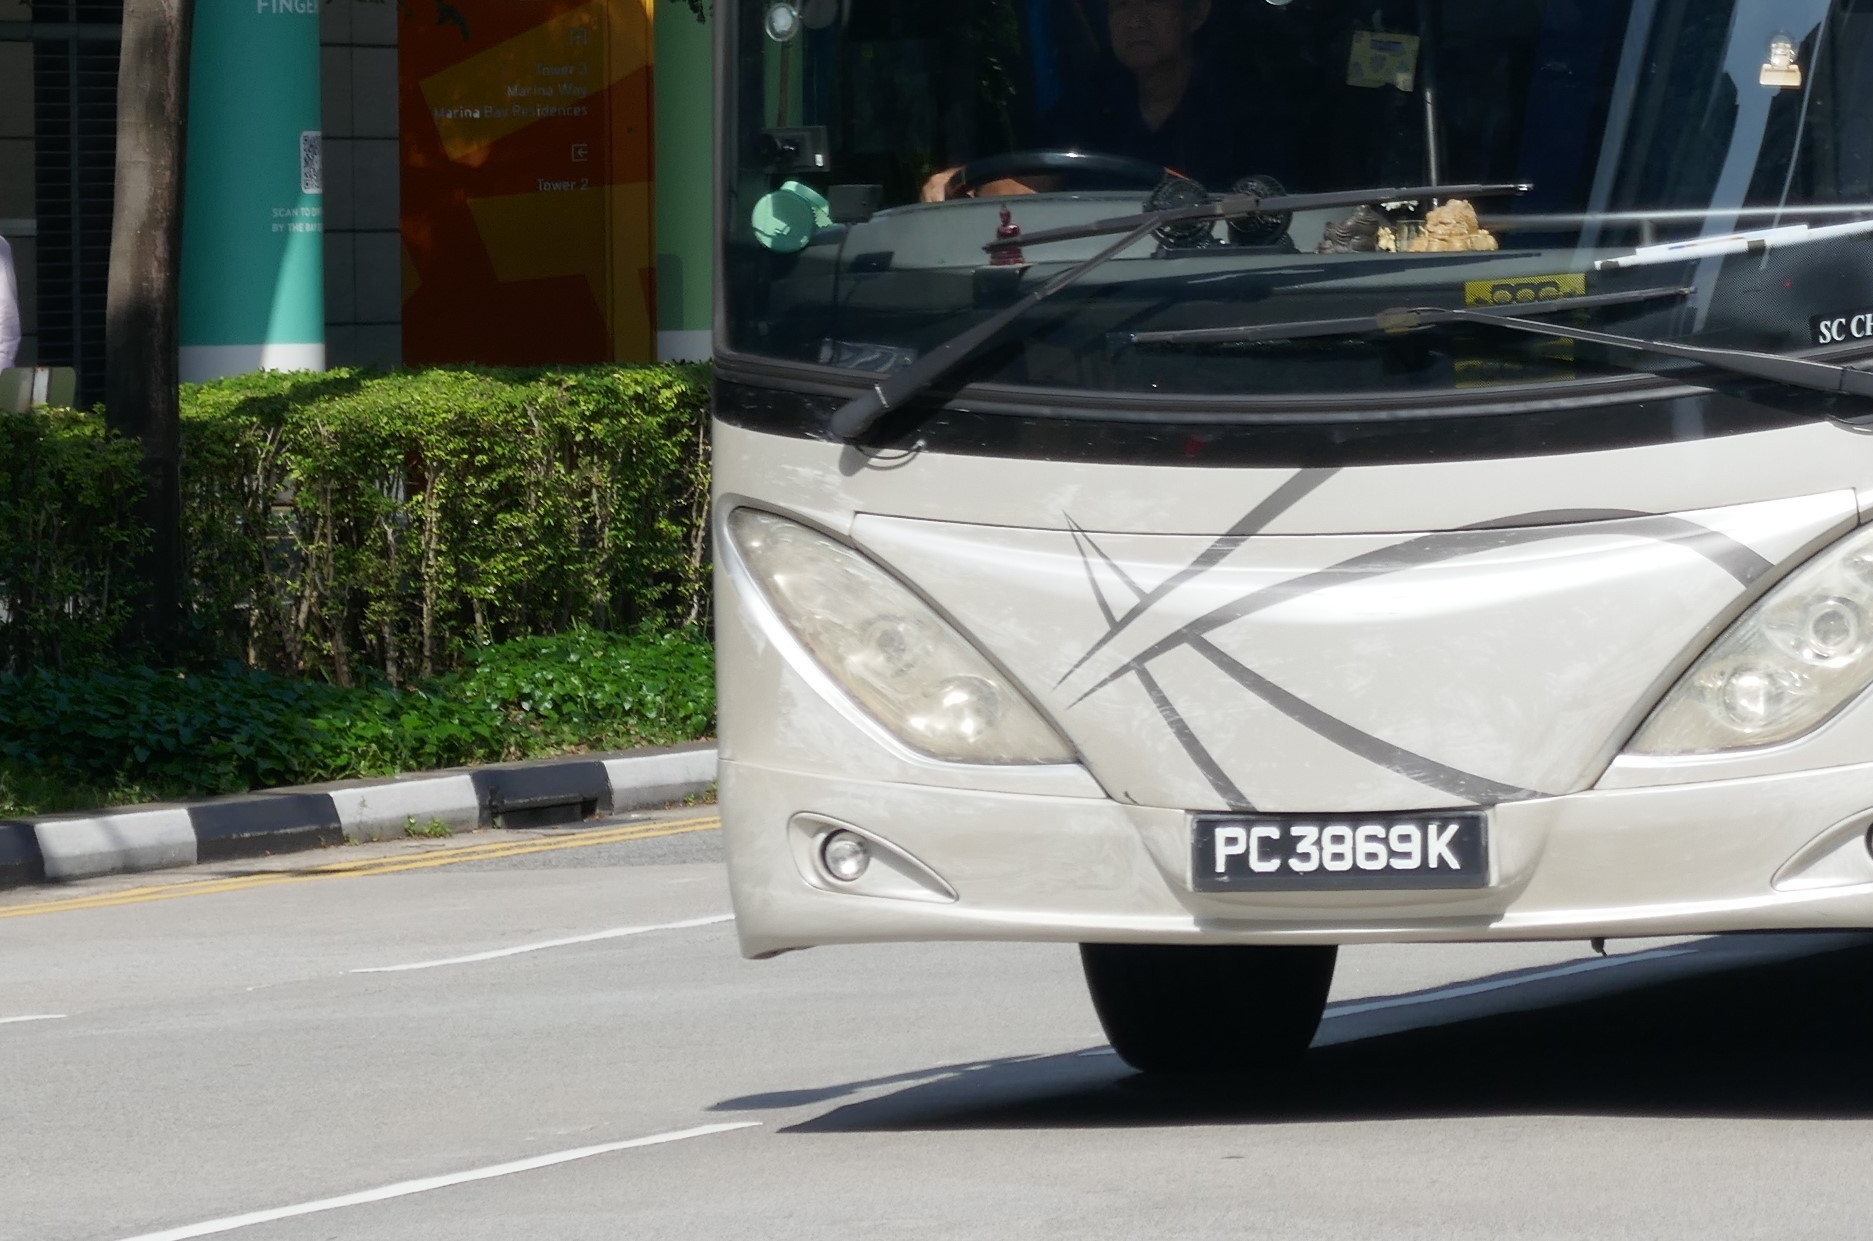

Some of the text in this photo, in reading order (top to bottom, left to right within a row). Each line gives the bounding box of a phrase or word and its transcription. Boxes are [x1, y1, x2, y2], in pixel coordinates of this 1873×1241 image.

[536, 62, 575, 76] Tower
[507, 83, 588, 99] Marina Way
[433, 103, 588, 120] Marina Bay Residences
[536, 178, 589, 191] Tower 2
[272, 208, 298, 218] SCAN
[272, 223, 284, 233] BY
[288, 223, 304, 233] THE
[1818, 318, 1846, 344] SC
[1214, 824, 1461, 873] PC3869K
